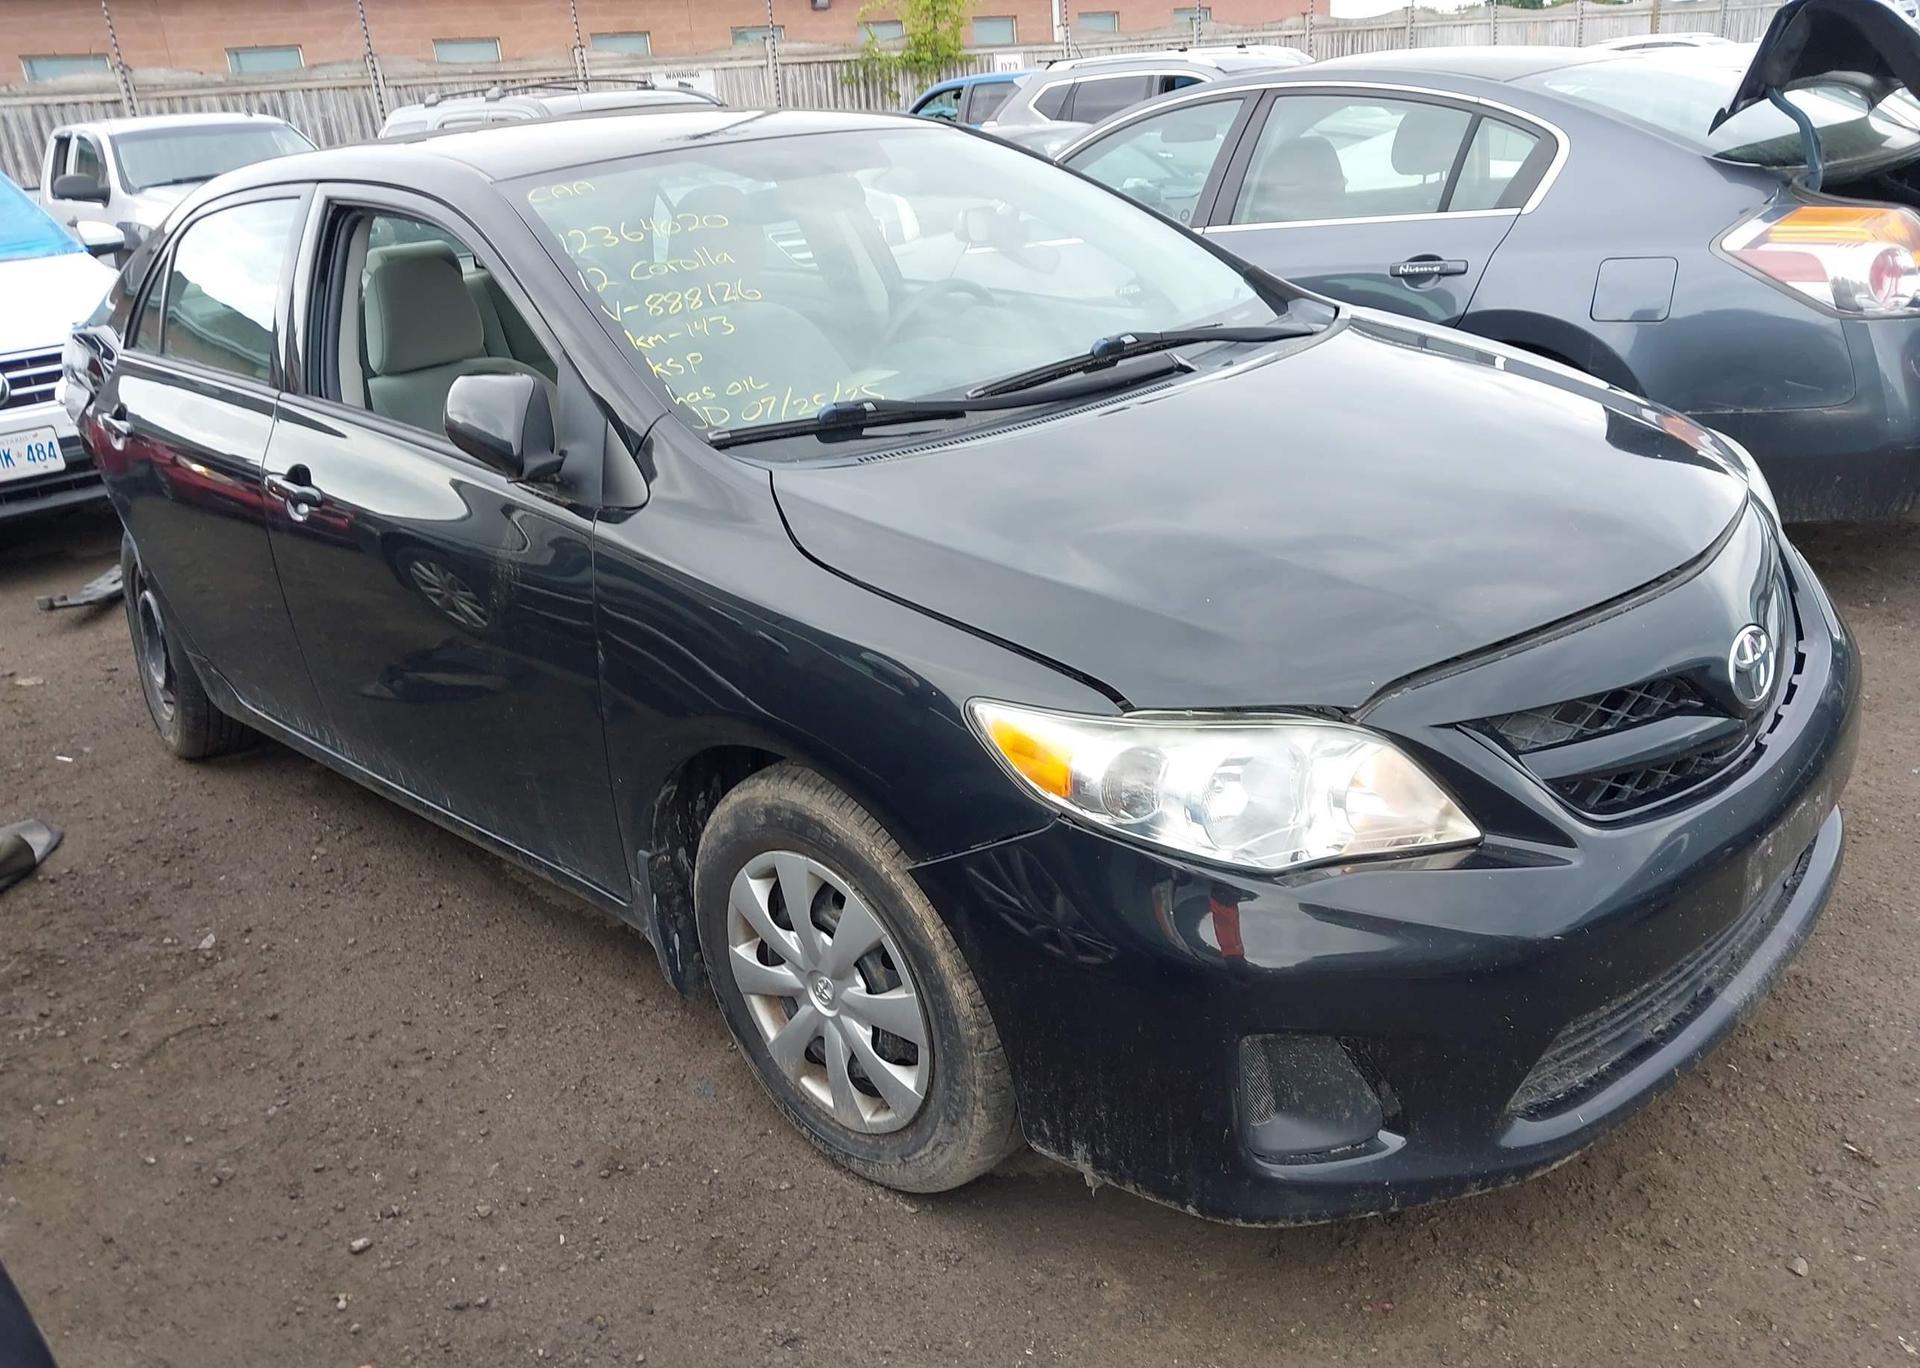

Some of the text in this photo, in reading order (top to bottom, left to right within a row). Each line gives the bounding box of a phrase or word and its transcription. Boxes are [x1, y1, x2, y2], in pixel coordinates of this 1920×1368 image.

[664, 71, 701, 80] WARNING
[577, 246, 736, 293] 12 Corolla
[665, 384, 716, 406] has
[27, 441, 57, 463] 484
